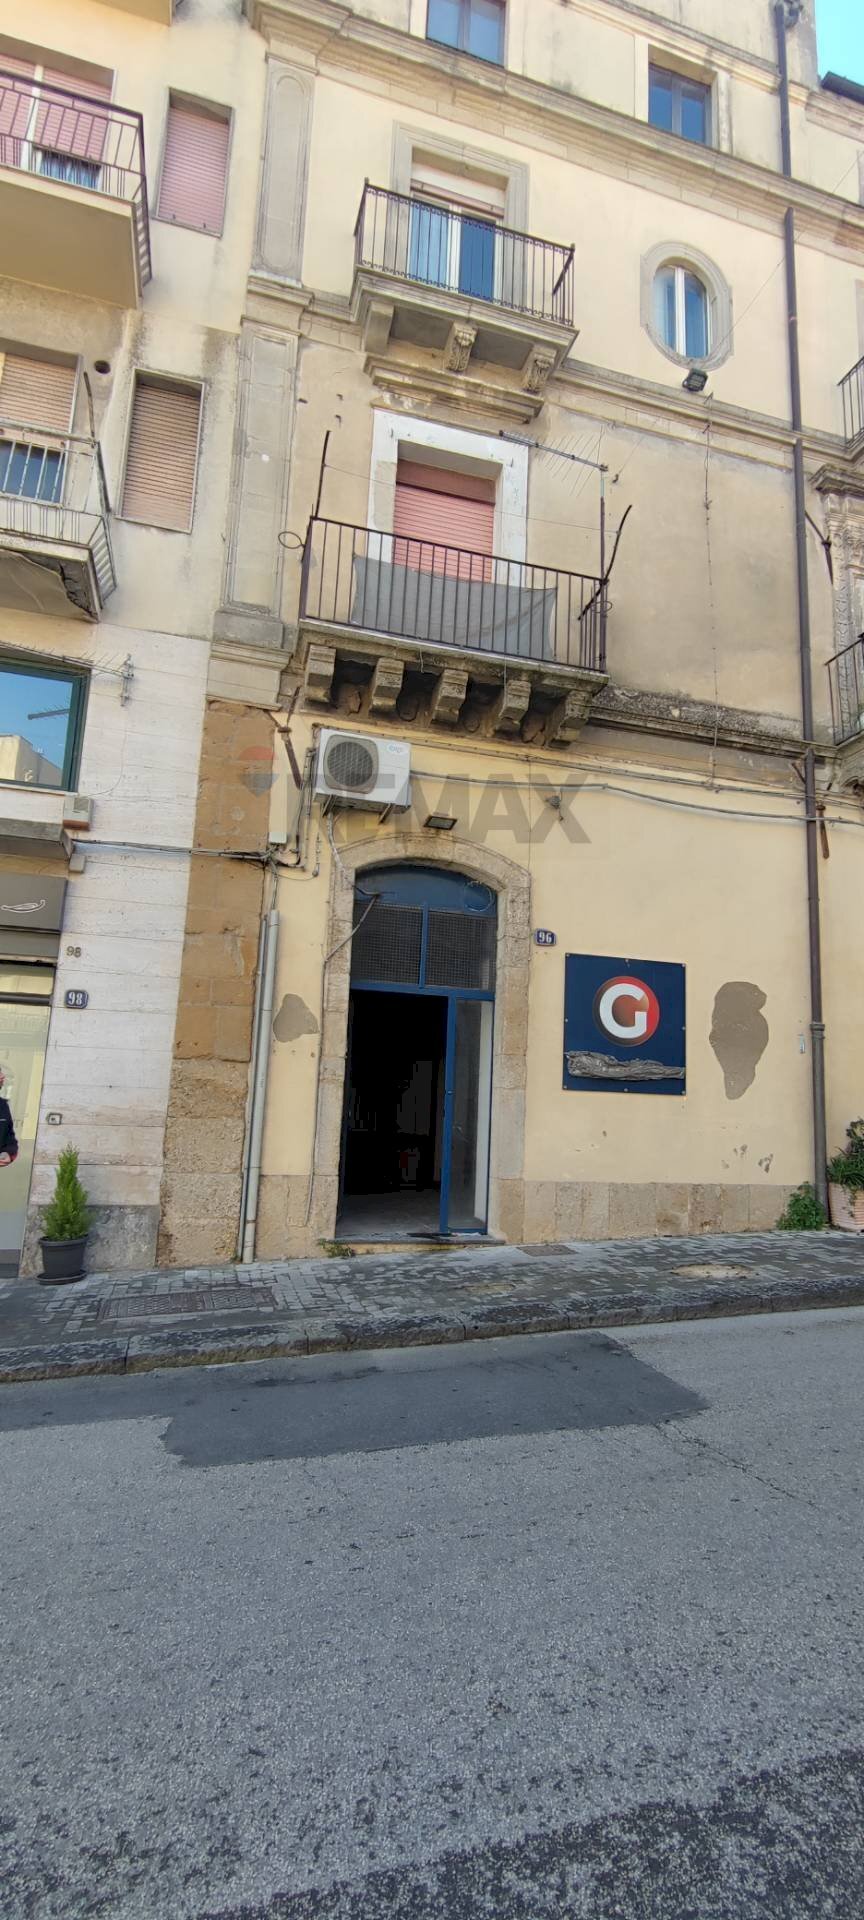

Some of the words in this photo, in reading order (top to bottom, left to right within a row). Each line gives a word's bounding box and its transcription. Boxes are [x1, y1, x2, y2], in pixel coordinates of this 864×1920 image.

[538, 931, 552, 943] 96
[66, 945, 82, 958] 98
[67, 991, 83, 1005] 98
[599, 982, 648, 1039] G
